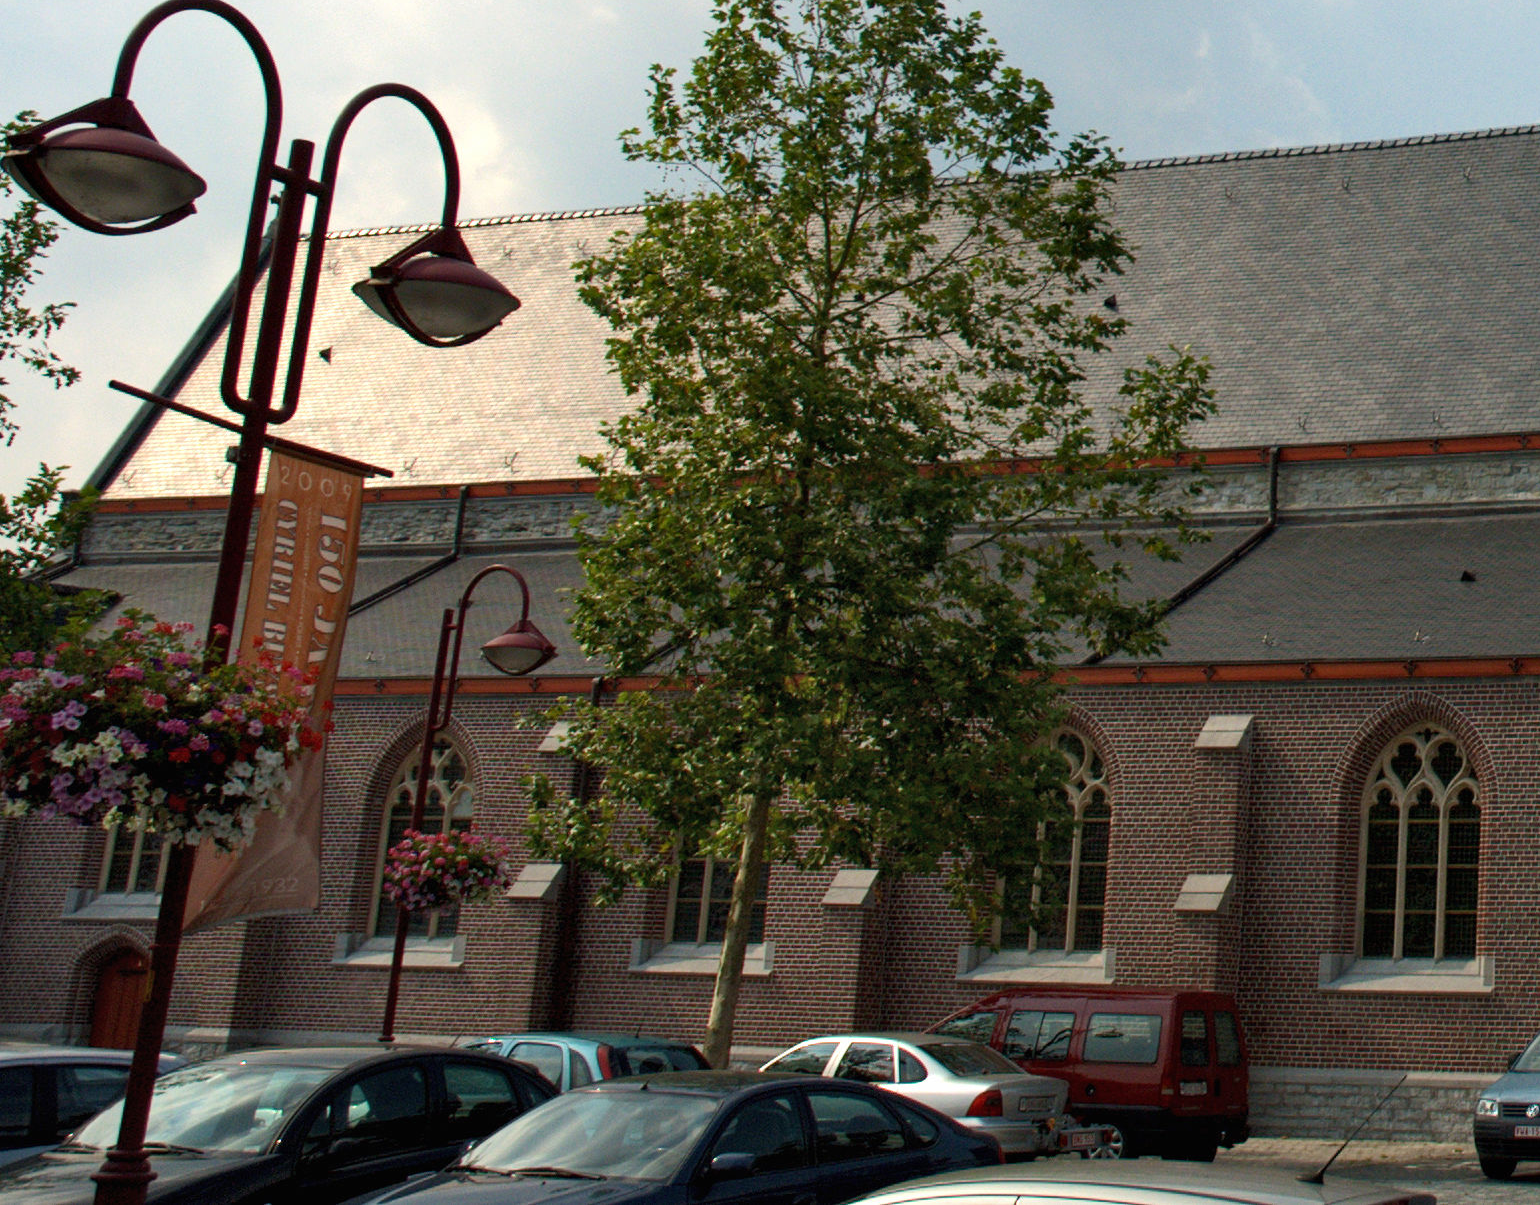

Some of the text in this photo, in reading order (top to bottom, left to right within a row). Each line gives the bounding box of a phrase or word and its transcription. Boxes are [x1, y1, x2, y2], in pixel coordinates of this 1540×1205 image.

[280, 465, 352, 502] 2009
[265, 498, 299, 612] CYRIEL
[317, 513, 348, 594] 150
